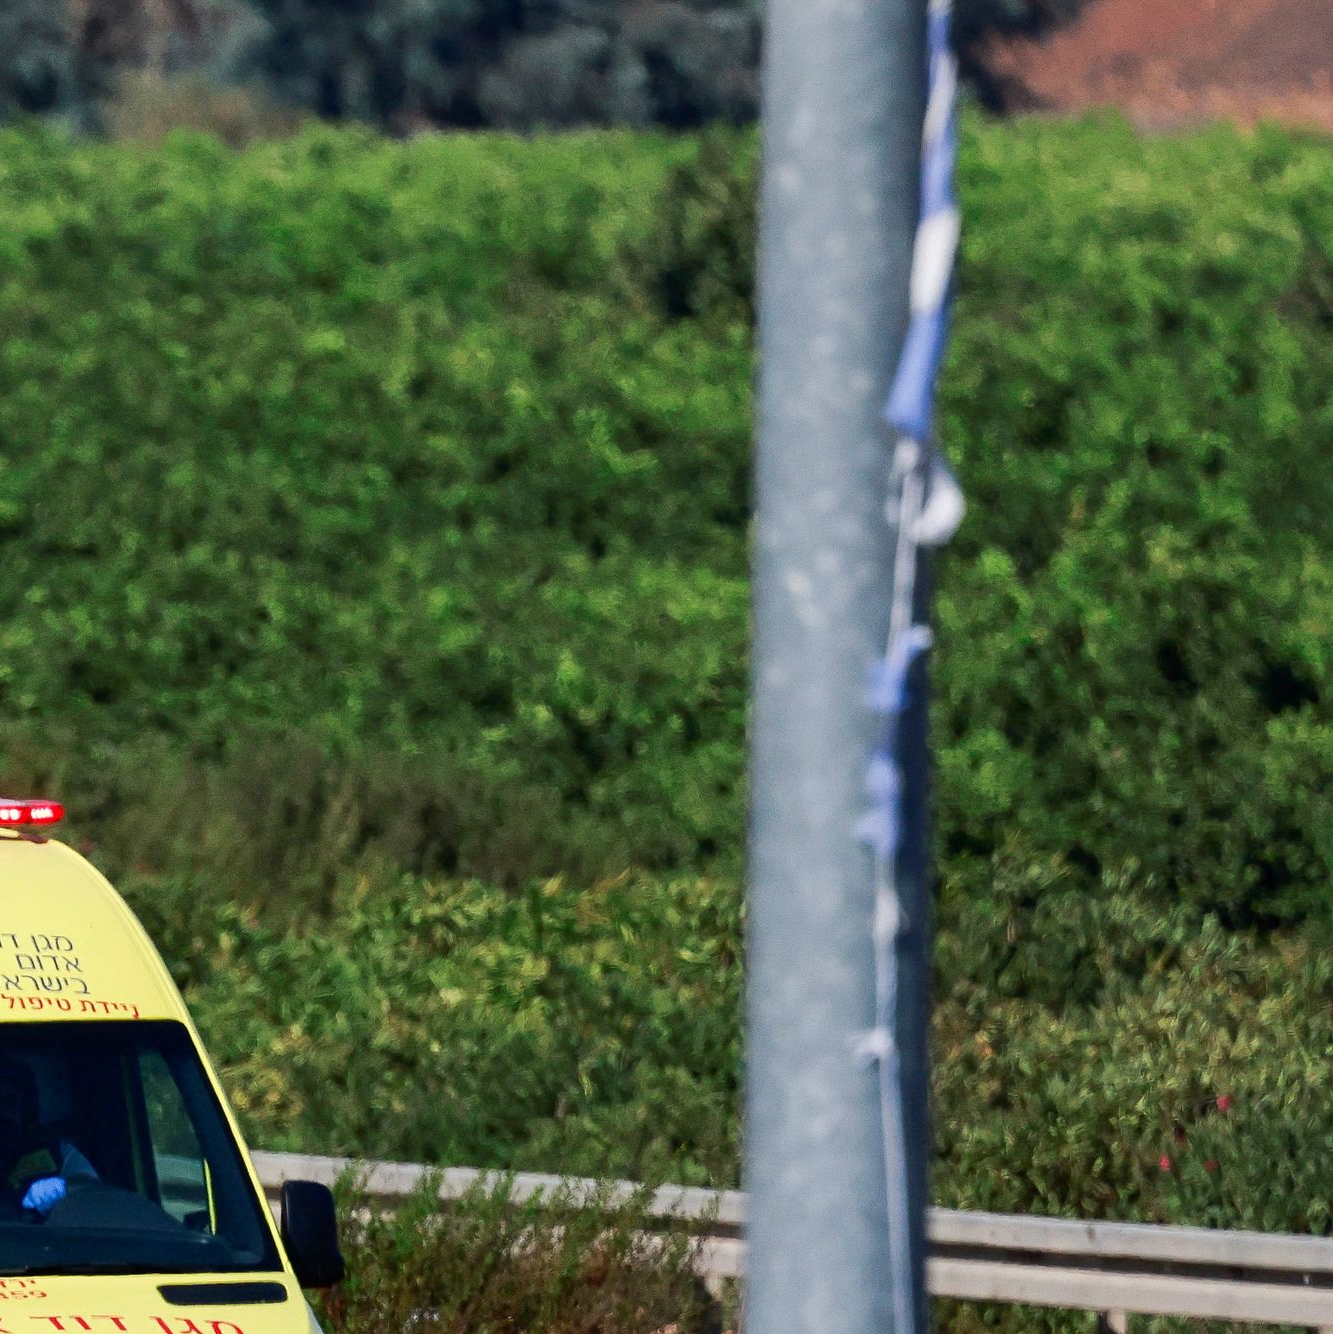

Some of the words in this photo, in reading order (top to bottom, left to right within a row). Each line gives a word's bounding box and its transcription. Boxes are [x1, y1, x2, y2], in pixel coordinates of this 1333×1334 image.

[30, 934, 73, 953] מגן
[15, 953, 83, 972] אדום
[0, 993, 71, 1012] טיפול
[80, 999, 140, 1020] ניידת
[29, 1314, 128, 1332] דוד
